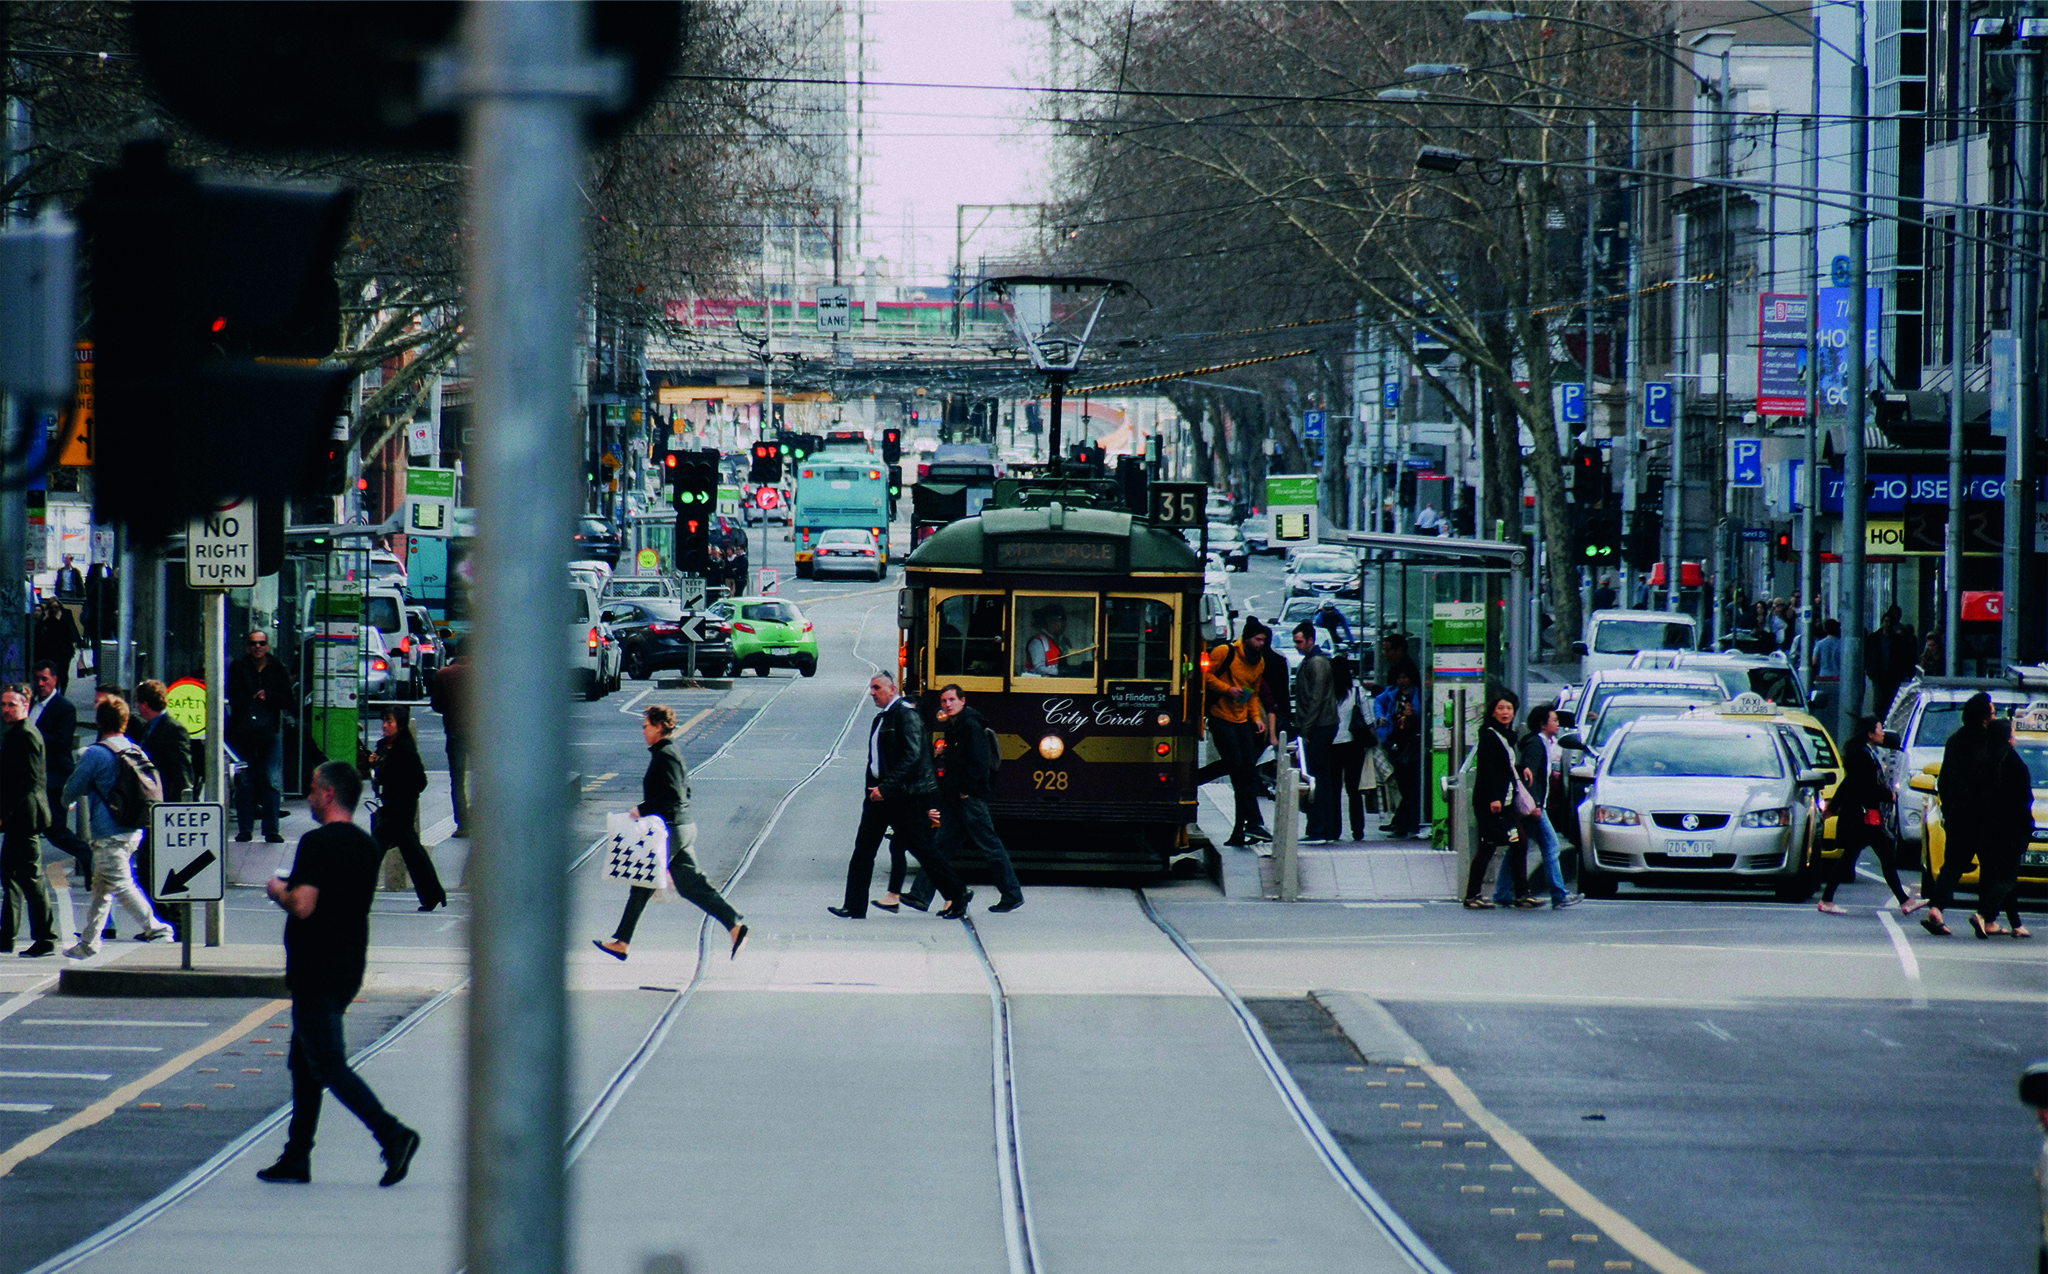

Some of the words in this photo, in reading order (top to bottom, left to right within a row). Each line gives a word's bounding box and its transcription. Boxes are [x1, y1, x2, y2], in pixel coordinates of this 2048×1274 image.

[820, 316, 846, 326] LANE
[1566, 386, 1580, 404] P
[1651, 386, 1667, 405] P
[1308, 414, 1320, 426] P
[1738, 443, 1757, 464] P
[1159, 492, 1195, 522] 35
[204, 517, 240, 538] NO
[196, 544, 249, 558] RIGHT
[1005, 542, 1043, 558] CITY
[1052, 543, 1112, 560] CIRCLE
[197, 564, 246, 579] TURN
[1111, 692, 1123, 701] via
[1125, 693, 1156, 701] Flinders
[1157, 693, 1166, 701] St
[1741, 698, 1761, 706] TAXI
[1042, 698, 1089, 732] City
[1092, 700, 1147, 725] Circle
[1731, 704, 1750, 713] BLACK
[1751, 705, 1769, 714] CABS
[1033, 770, 1069, 790] 928
[165, 812, 211, 827] KEEP
[167, 832, 209, 847] LEFT
